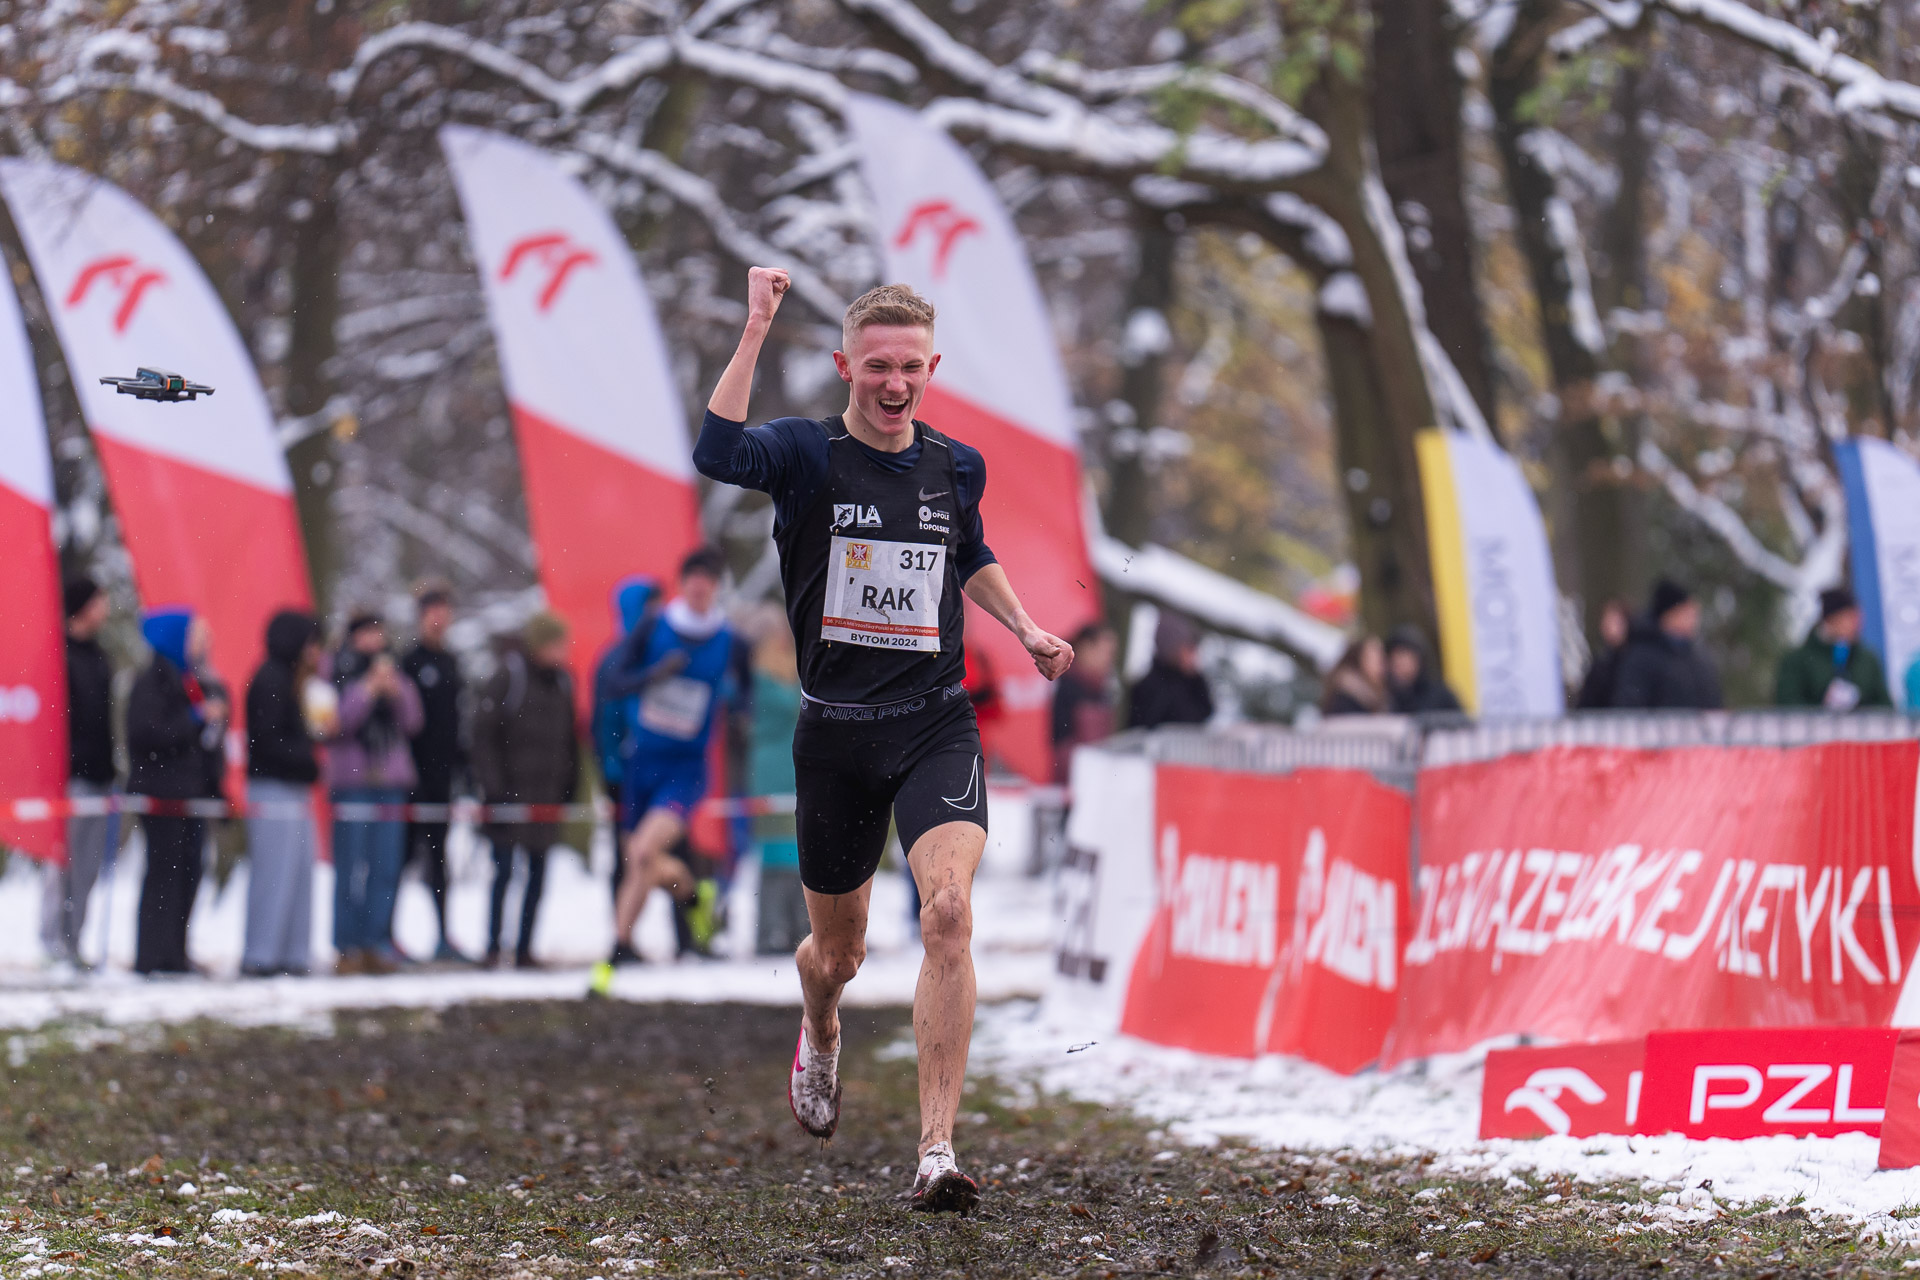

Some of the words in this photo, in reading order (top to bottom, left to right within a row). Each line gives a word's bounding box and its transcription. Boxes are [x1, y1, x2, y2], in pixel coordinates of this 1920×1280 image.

[932, 511, 950, 521] OPOLE
[899, 549, 938, 571] 317
[861, 584, 916, 612] RAK
[850, 632, 890, 646] BYTOM
[891, 637, 918, 647] 2024
[822, 705, 877, 721] NIKE
[877, 697, 926, 720] PRO
